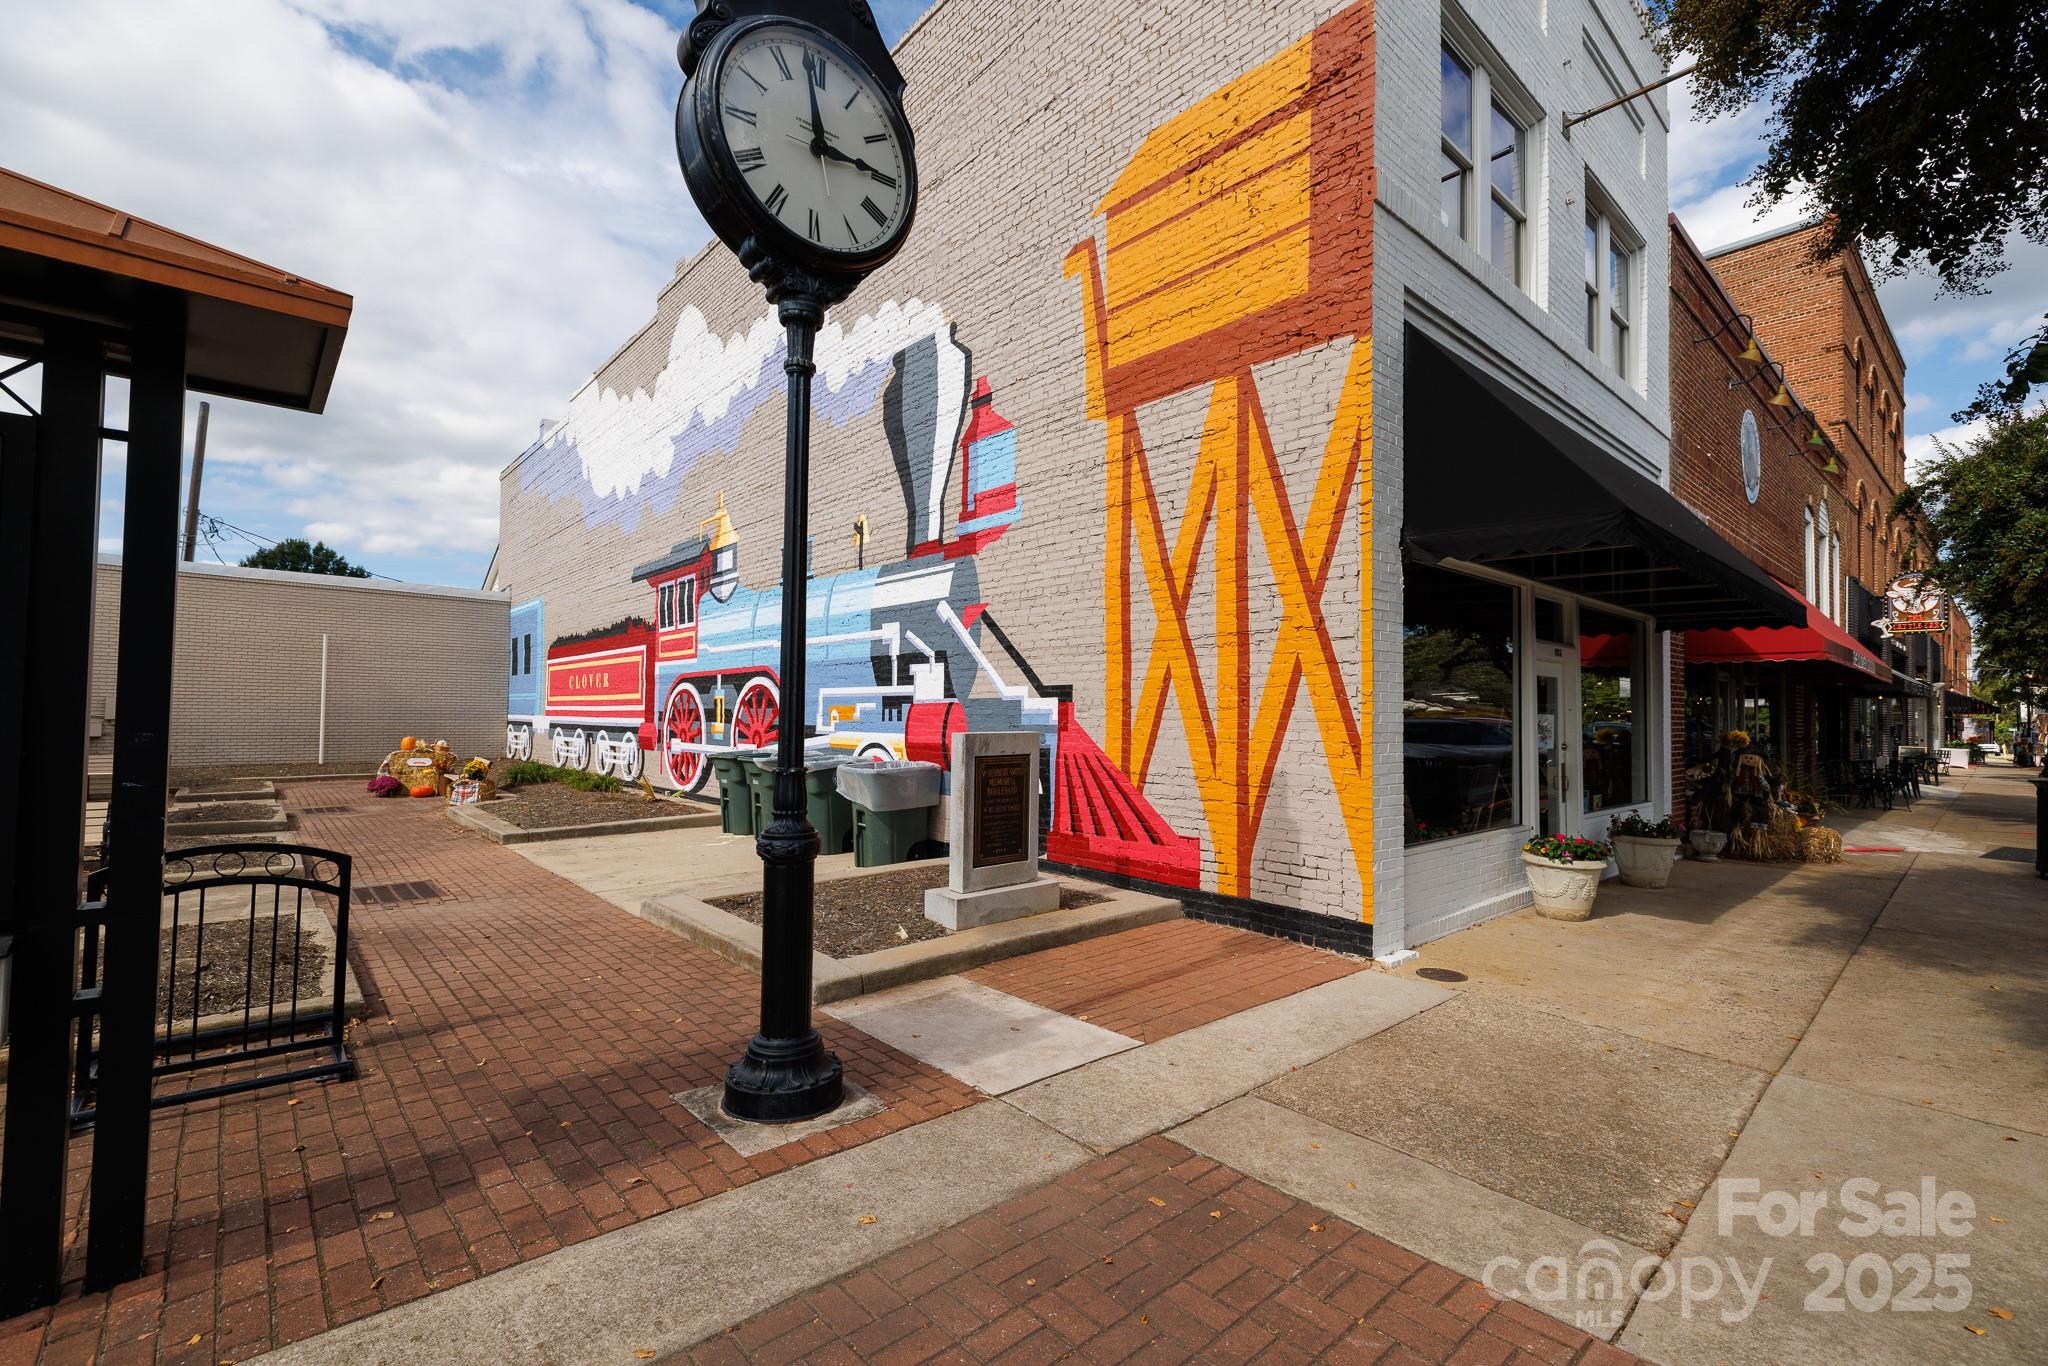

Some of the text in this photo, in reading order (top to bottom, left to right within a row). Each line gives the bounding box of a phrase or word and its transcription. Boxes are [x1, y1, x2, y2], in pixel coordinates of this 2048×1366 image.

[736, 57, 769, 97] X
[863, 133, 888, 145] II
[569, 672, 609, 689] CLOVER
